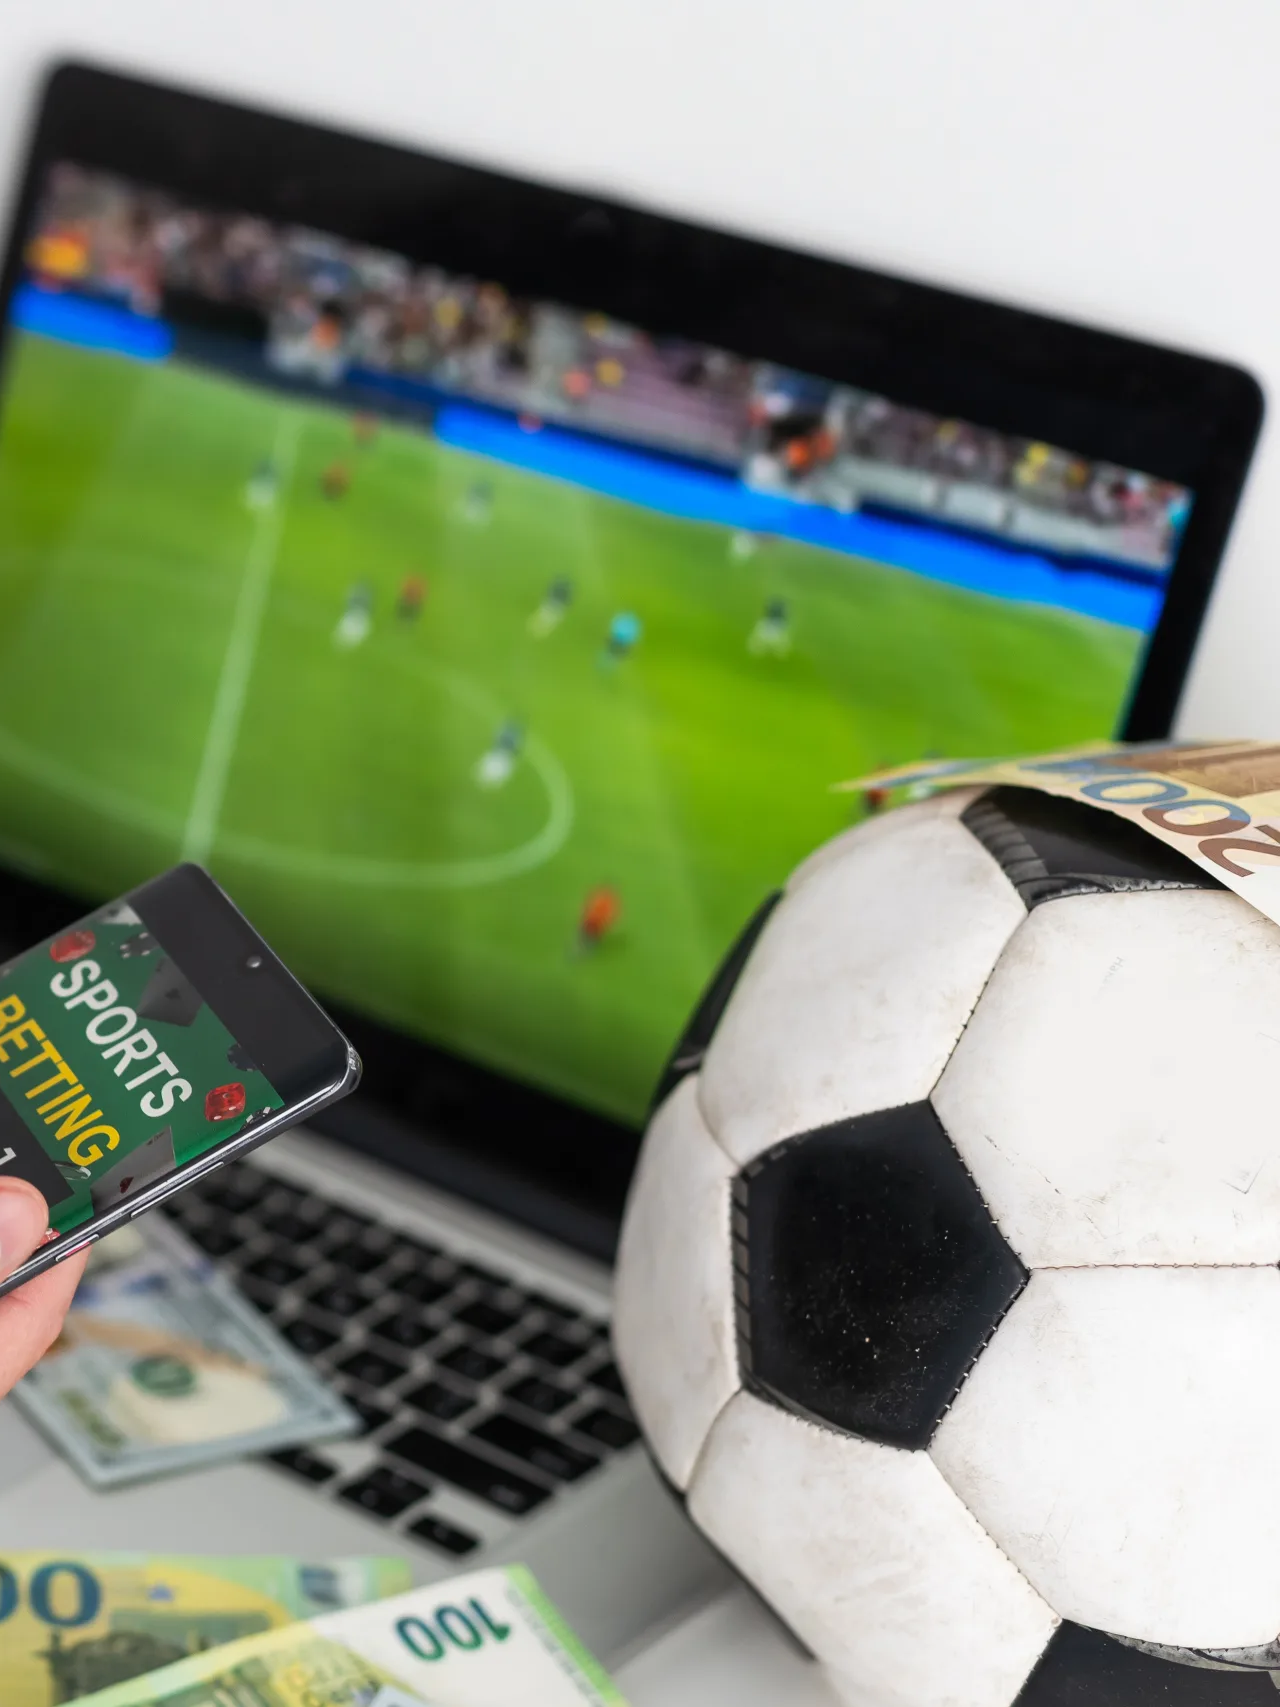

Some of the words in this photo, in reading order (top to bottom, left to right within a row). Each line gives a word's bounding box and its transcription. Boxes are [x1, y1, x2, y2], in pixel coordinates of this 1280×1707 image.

[1080, 778, 1280, 877] 200
[49, 959, 193, 1118] SPORTS
[394, 1597, 511, 1662] 100
